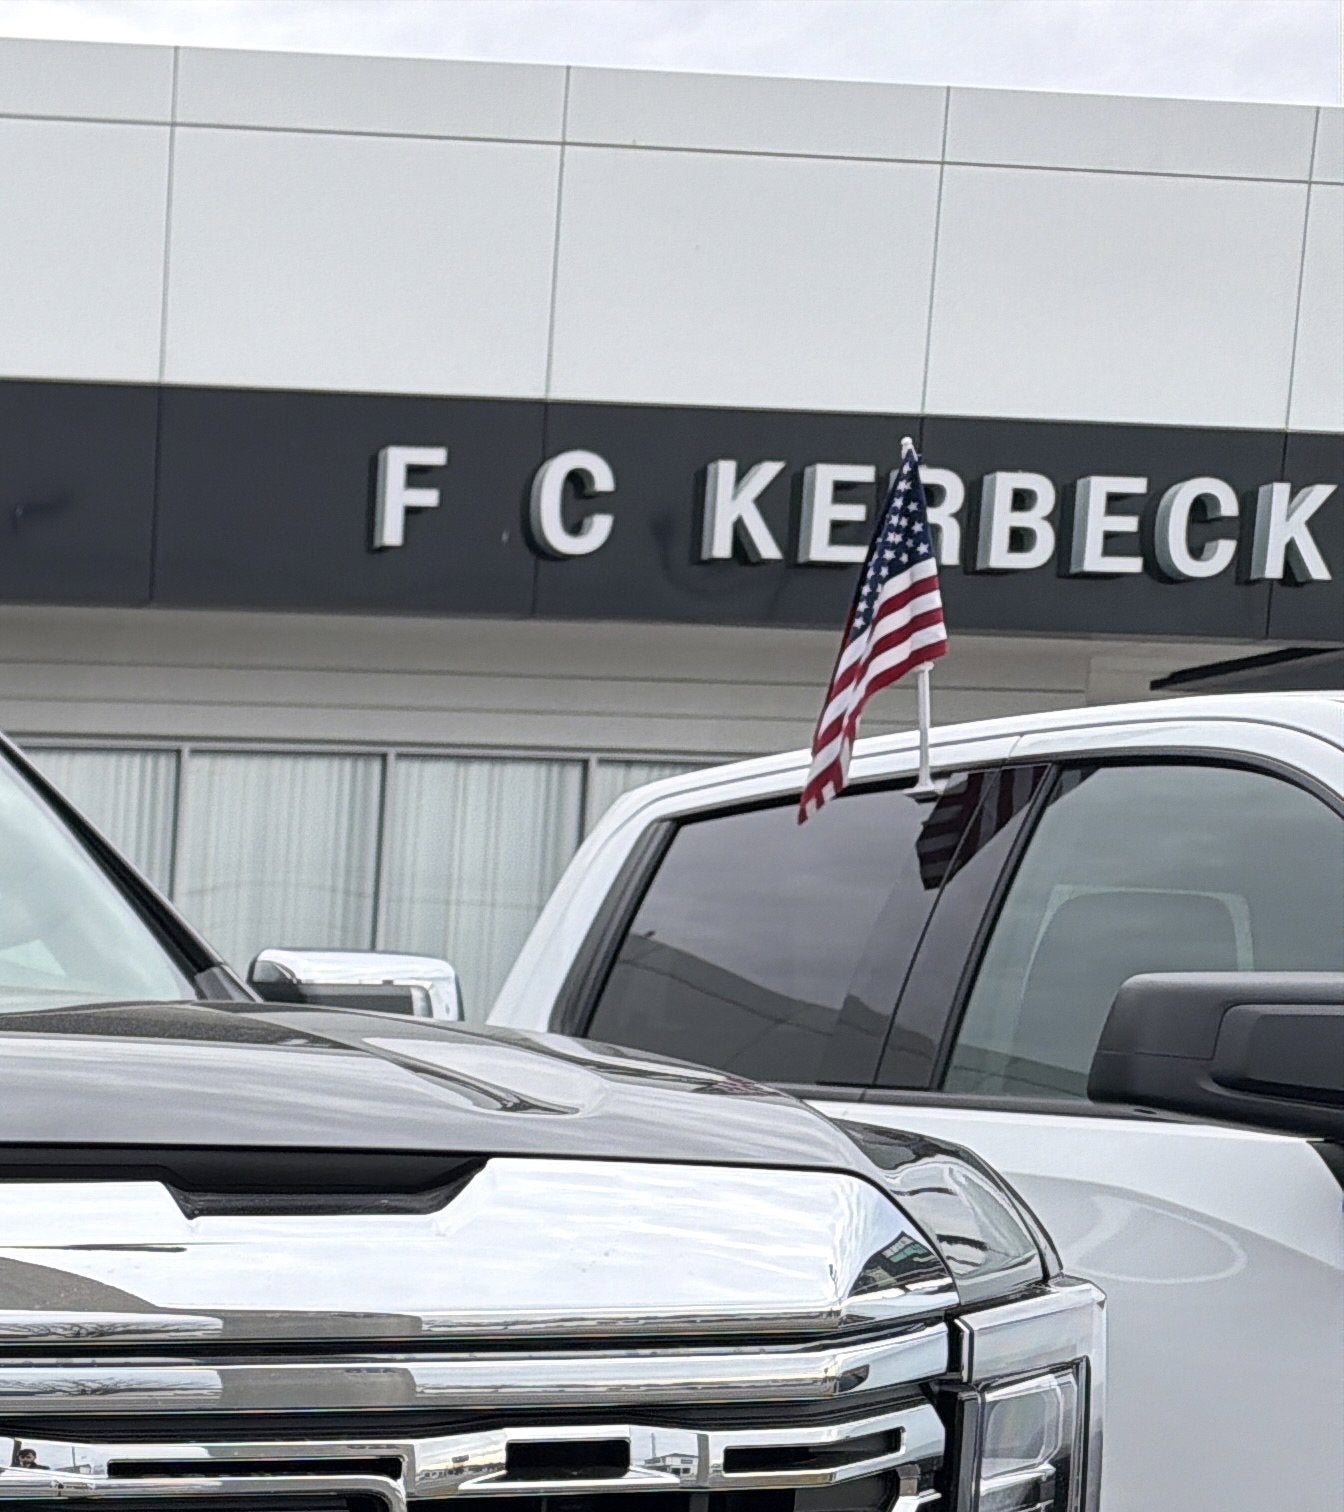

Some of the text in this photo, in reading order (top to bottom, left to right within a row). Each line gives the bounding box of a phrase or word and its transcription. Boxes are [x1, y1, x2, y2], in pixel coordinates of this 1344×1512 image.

[375, 446, 1339, 581] F C KERBECK
